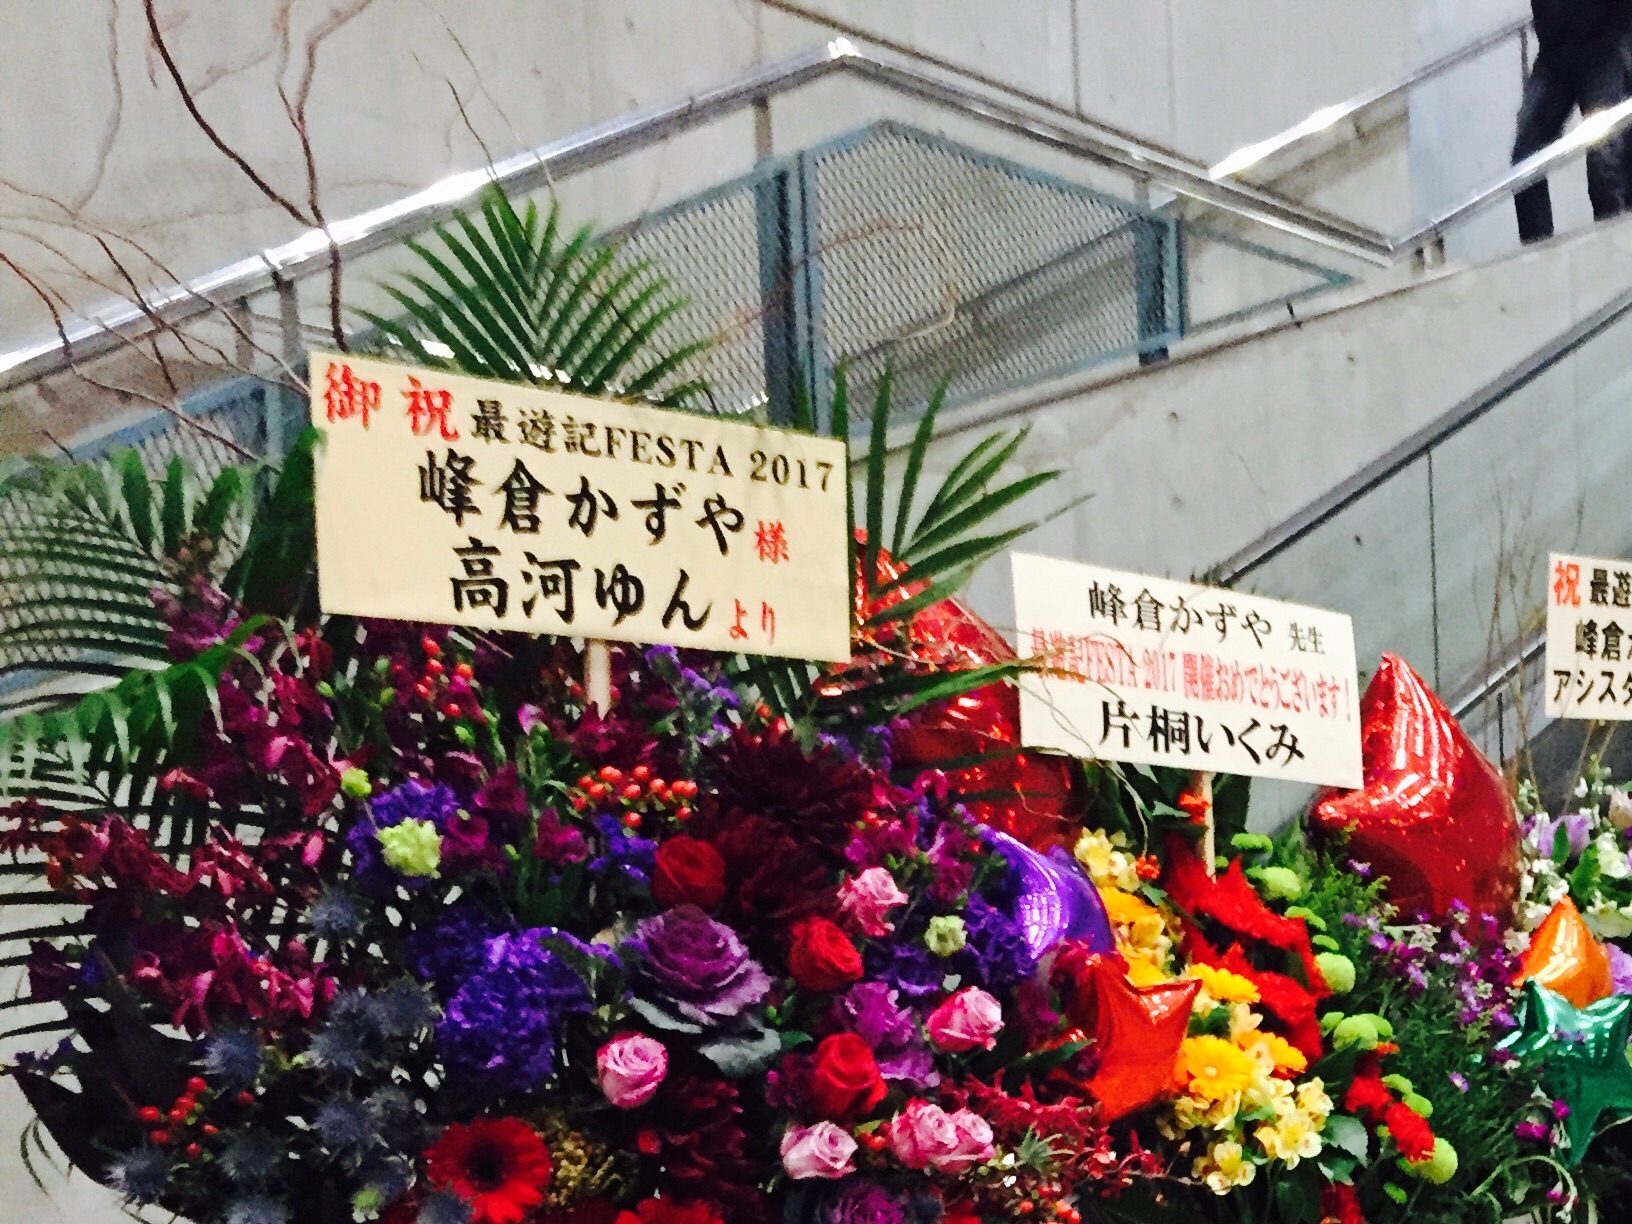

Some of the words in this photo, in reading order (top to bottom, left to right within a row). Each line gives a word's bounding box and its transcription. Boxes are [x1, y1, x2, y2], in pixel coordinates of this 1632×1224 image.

[471, 399, 735, 478] 最遊記FESTA
[749, 449, 835, 493] 2017
[1088, 580, 1273, 650] 峰倉かずや
[1288, 621, 1326, 655] 先生
[1553, 560, 1581, 608] 祝
[1098, 700, 1305, 767] 片桐いくみ
